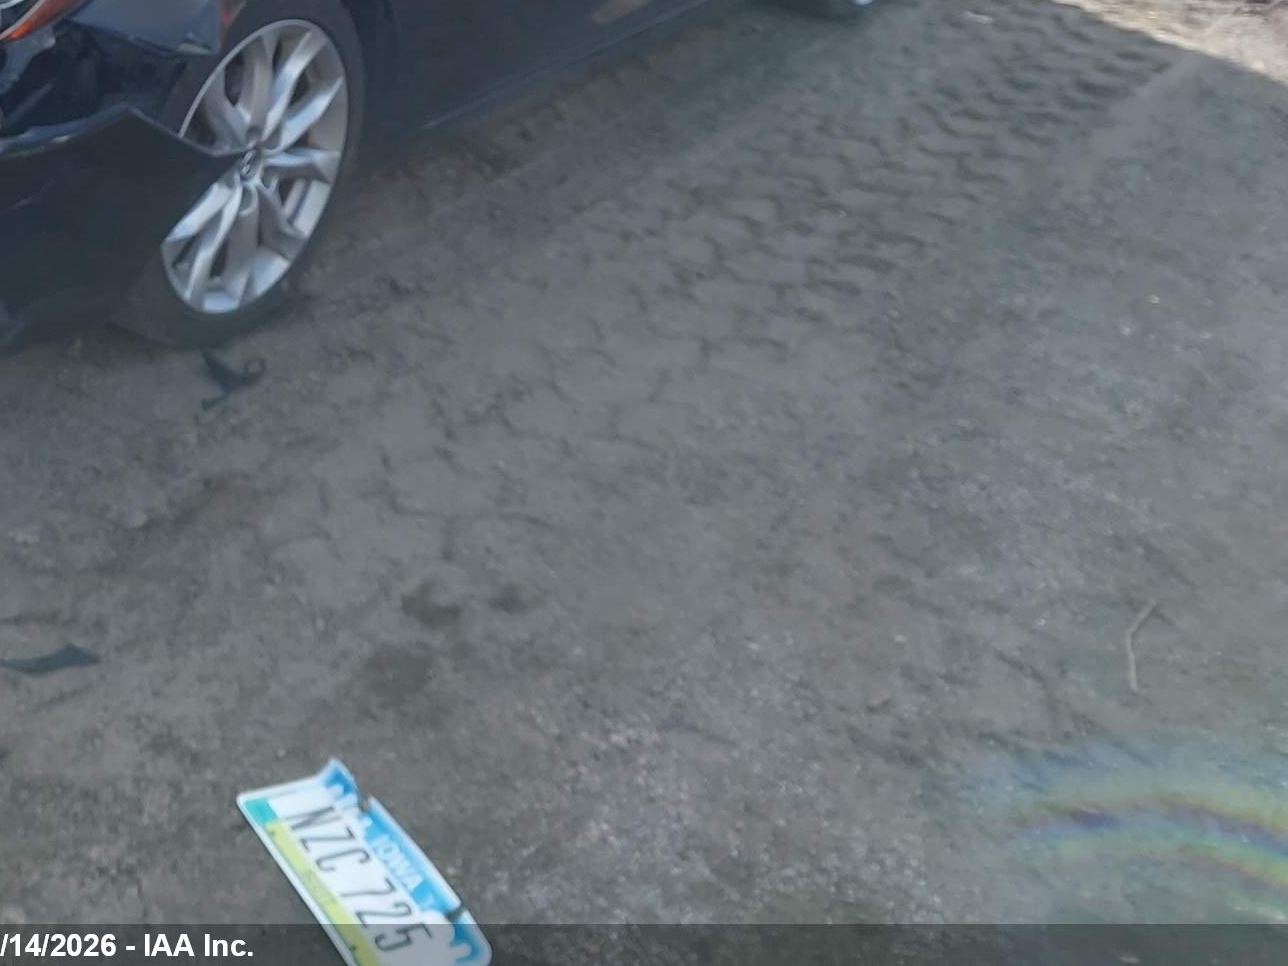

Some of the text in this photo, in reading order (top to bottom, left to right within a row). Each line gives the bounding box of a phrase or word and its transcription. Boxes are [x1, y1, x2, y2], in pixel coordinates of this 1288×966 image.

[284, 805, 433, 953] NZC 725
[373, 835, 423, 890] IOWA
